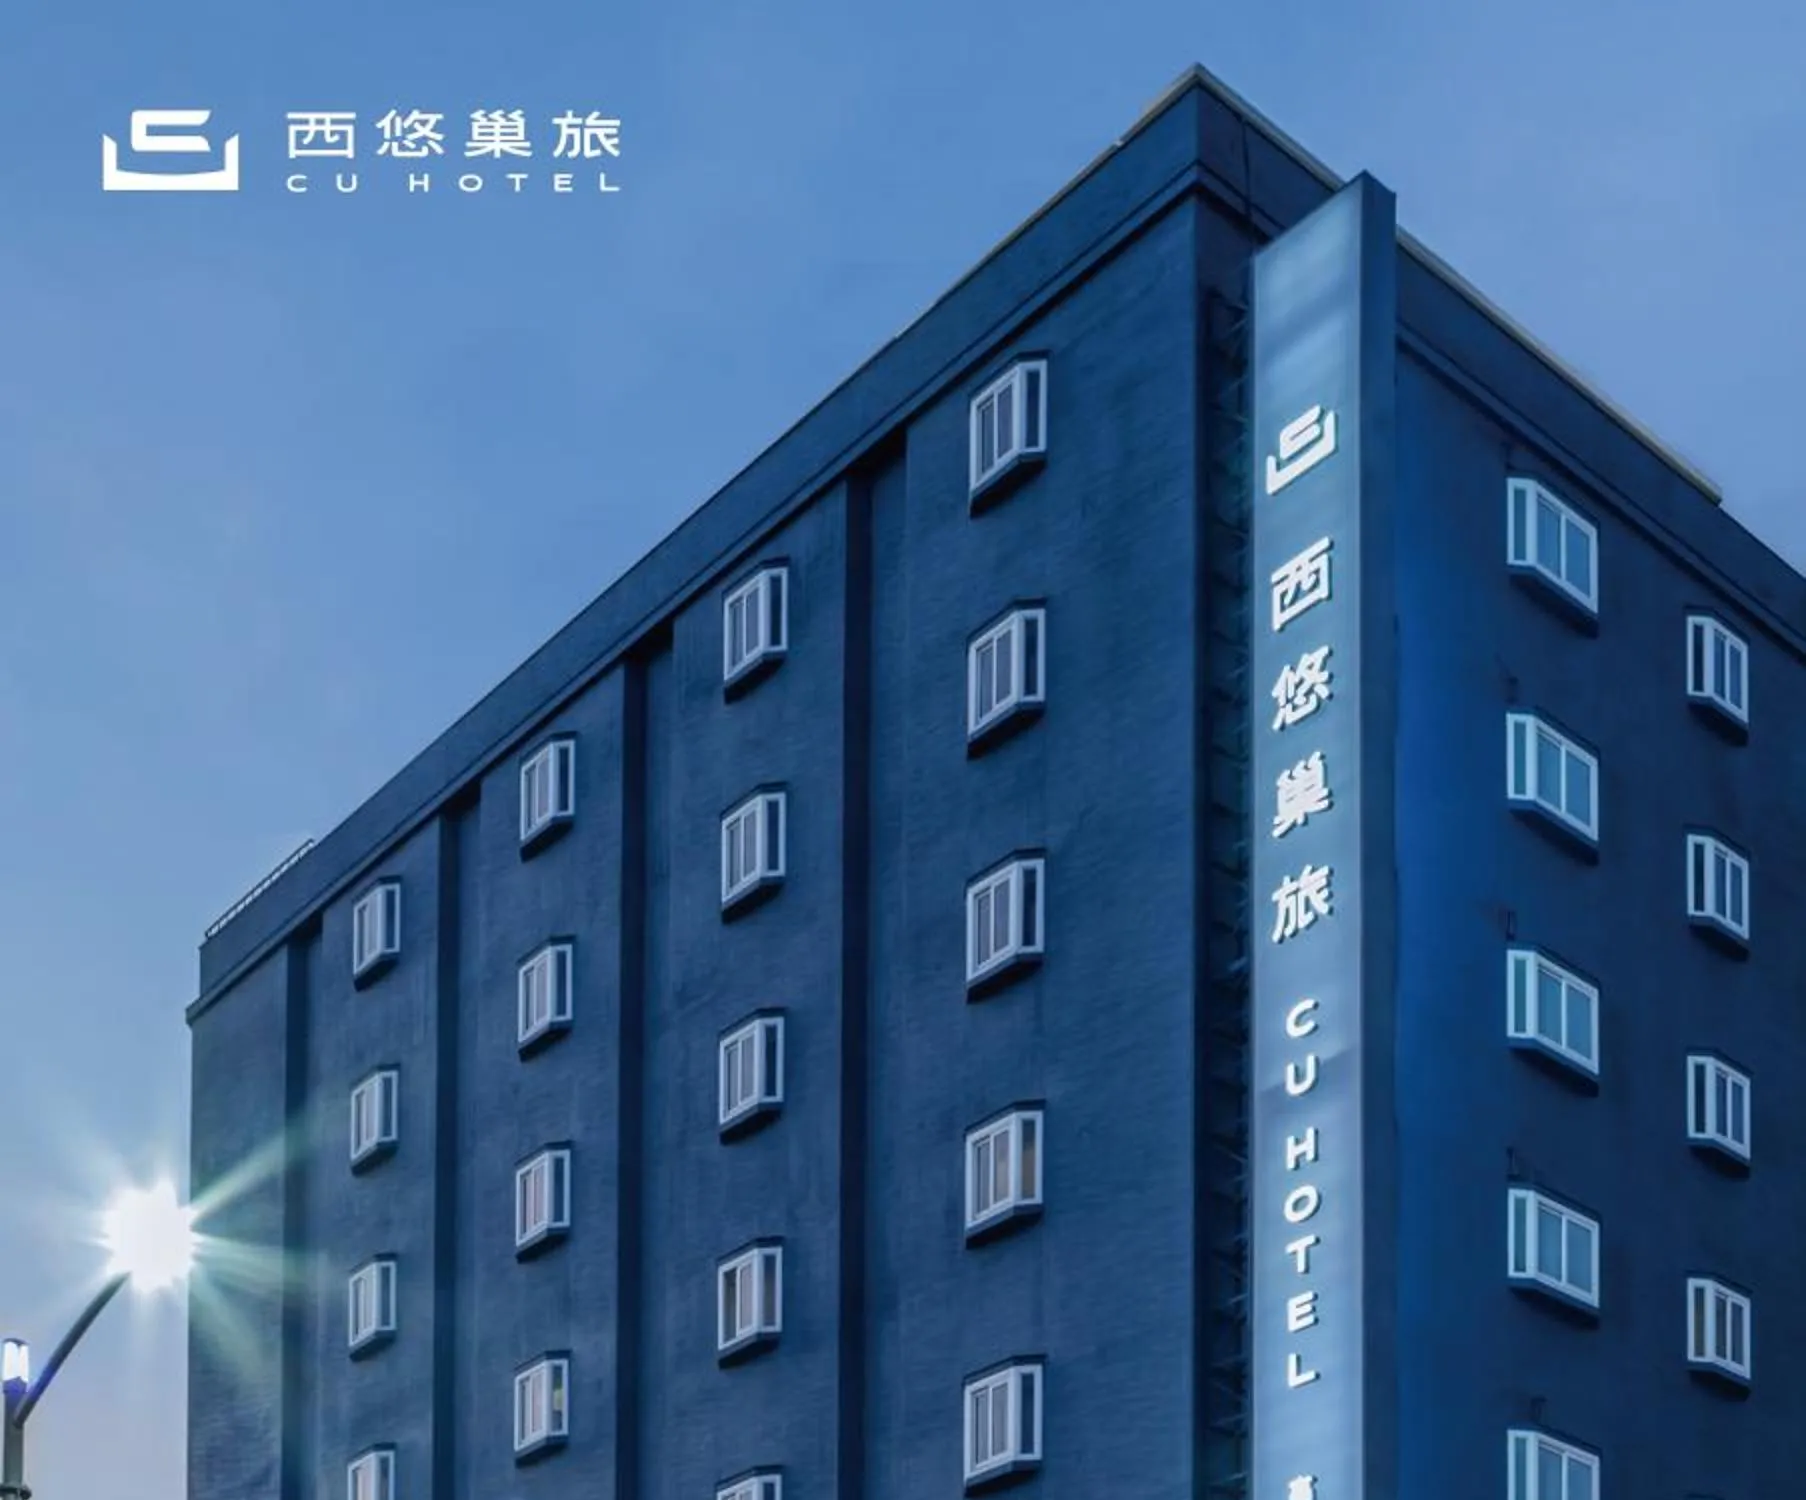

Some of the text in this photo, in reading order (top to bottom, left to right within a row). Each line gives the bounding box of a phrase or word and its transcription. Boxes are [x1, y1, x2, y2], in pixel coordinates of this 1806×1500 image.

[1271, 536, 1332, 945] 西悠巢旅
[1284, 998, 1320, 1390] CU HOTEL
